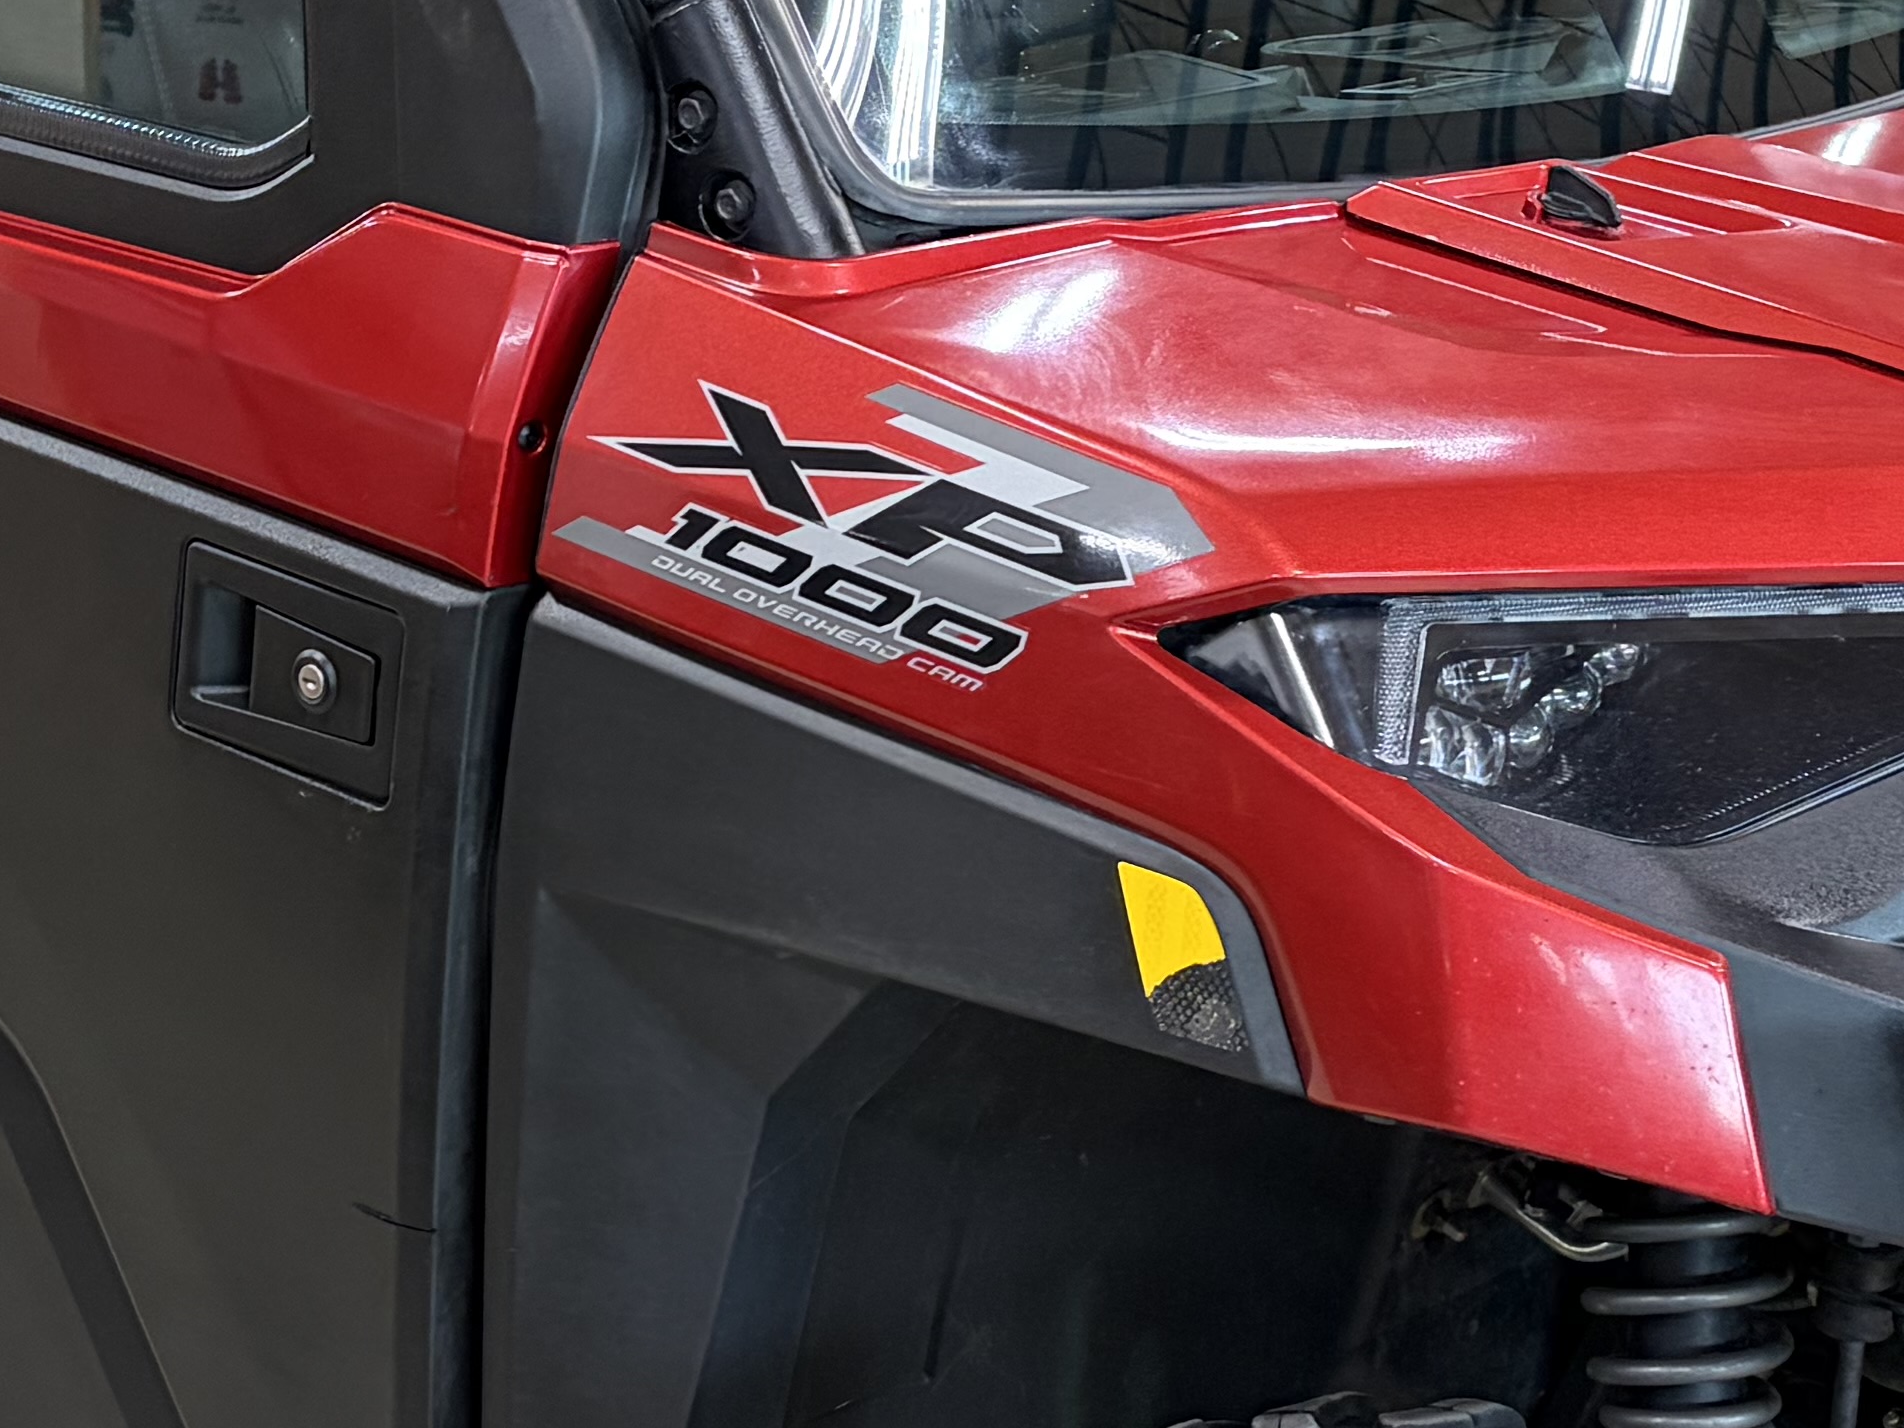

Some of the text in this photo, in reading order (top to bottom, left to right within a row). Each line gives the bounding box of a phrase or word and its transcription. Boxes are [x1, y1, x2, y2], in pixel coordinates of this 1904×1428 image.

[586, 378, 1136, 592] XP
[650, 553, 985, 694] DUAL OVERHEAD CAM
[657, 501, 1029, 677] 1000
